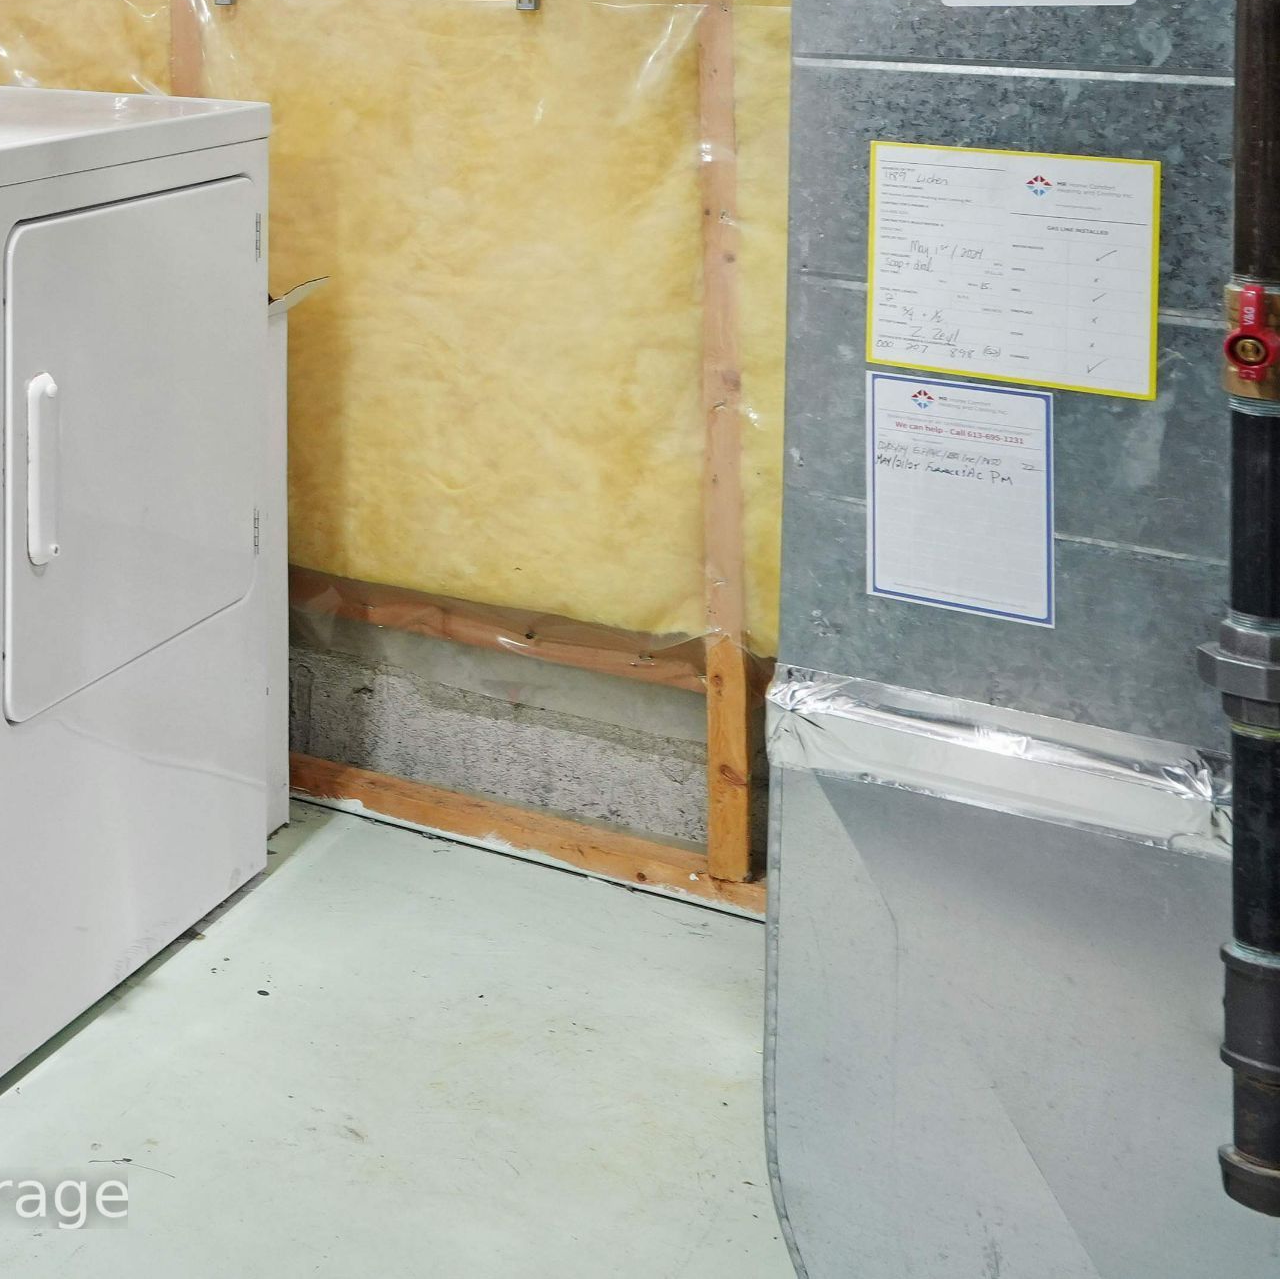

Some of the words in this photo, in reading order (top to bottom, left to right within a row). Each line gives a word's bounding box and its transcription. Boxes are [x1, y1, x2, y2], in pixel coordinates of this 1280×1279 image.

[910, 240, 930, 258] May
[895, 421, 908, 429] We
[909, 423, 924, 431] can
[925, 424, 944, 435] help
[949, 428, 966, 437] Call
[967, 430, 1025, 445] 613-695-1231
